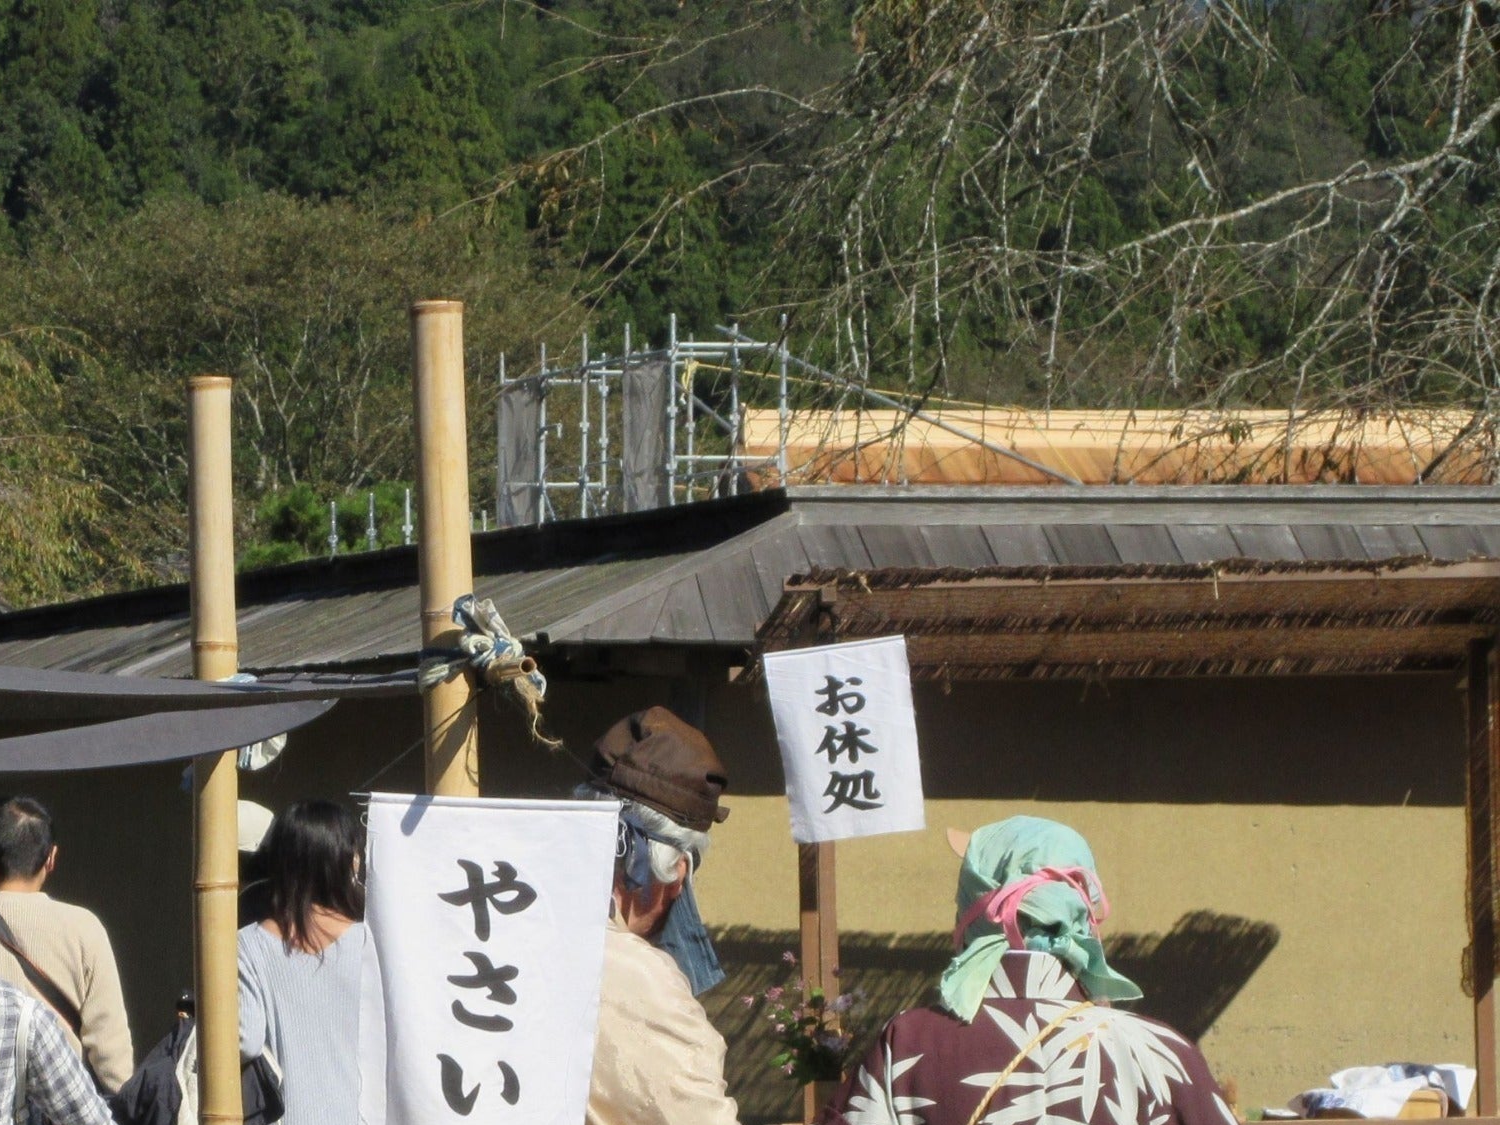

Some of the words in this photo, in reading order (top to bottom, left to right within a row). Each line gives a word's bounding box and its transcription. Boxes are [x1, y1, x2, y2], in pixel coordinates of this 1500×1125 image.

[814, 675, 885, 814] お休処
[436, 858, 538, 1117] やさい
